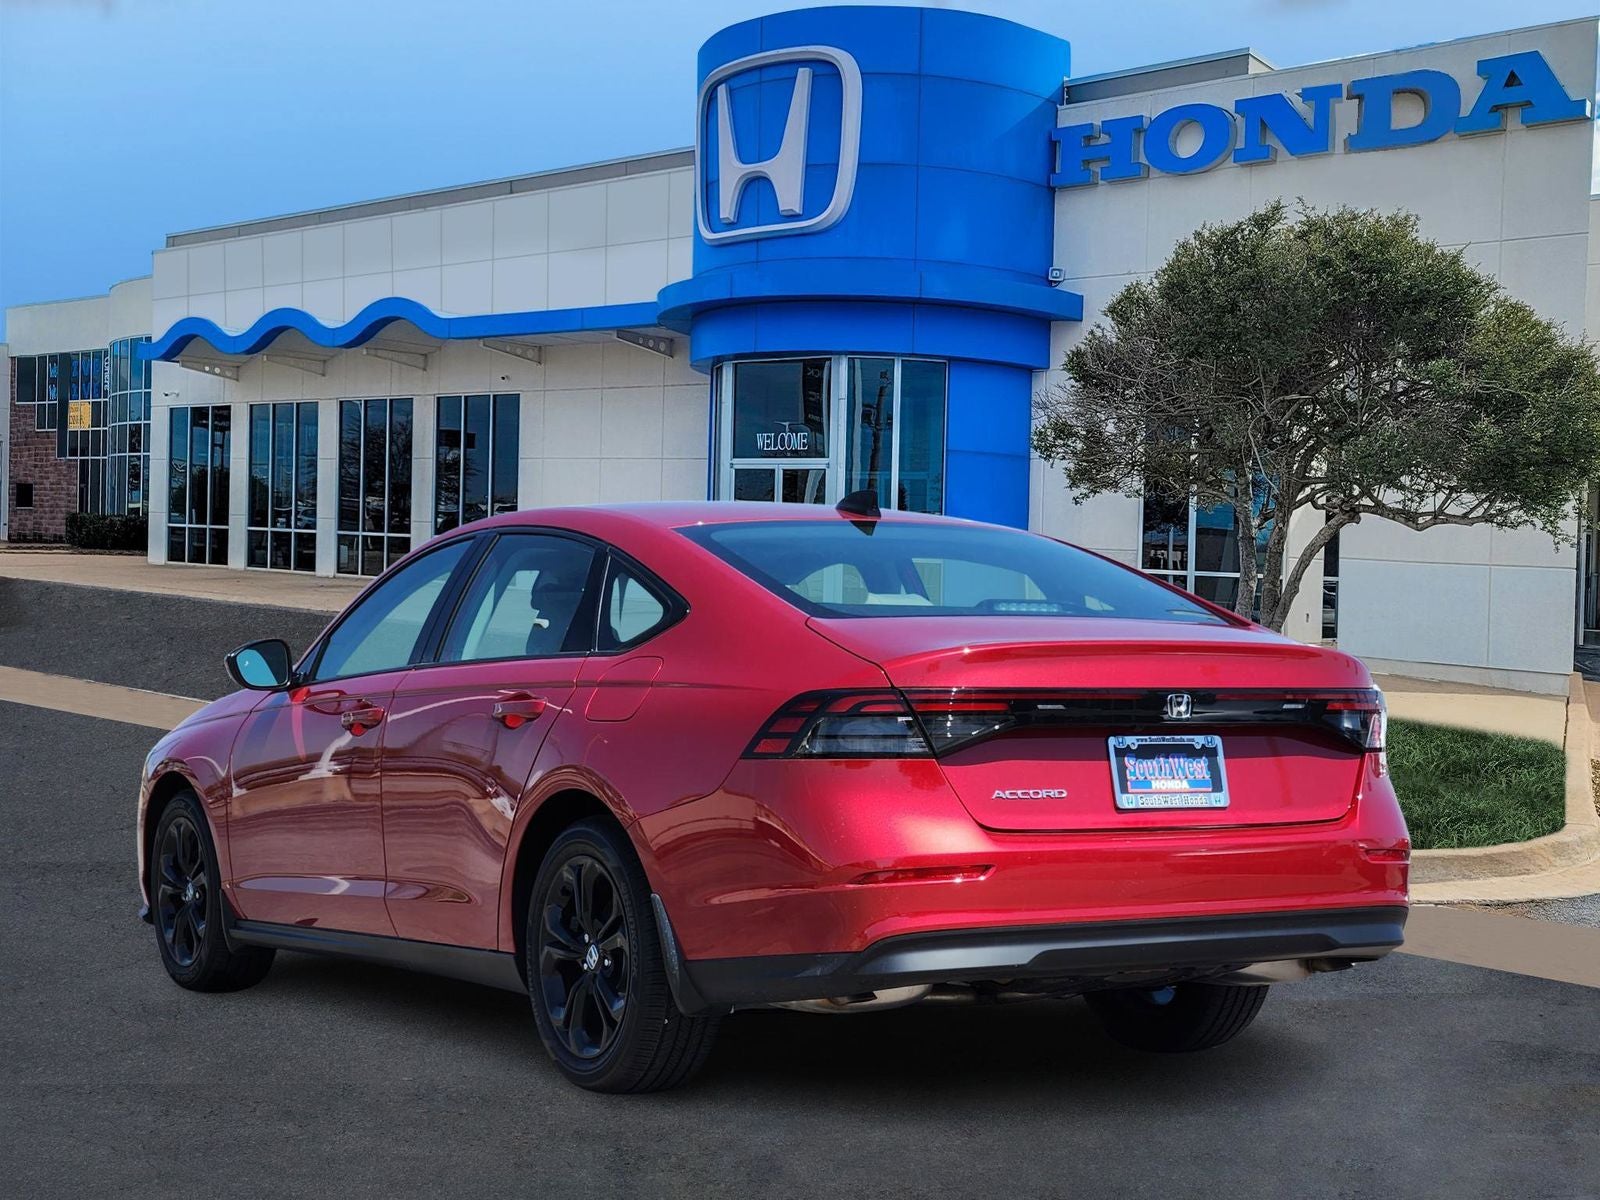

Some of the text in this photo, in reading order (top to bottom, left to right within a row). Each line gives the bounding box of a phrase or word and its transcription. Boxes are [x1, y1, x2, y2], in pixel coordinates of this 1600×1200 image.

[1050, 50, 1591, 188] HONDA
[756, 433, 808, 450] WELCOME
[1125, 754, 1210, 779] SouthWest
[1151, 780, 1190, 789] HONDA
[992, 788, 1068, 800] ACCORD
